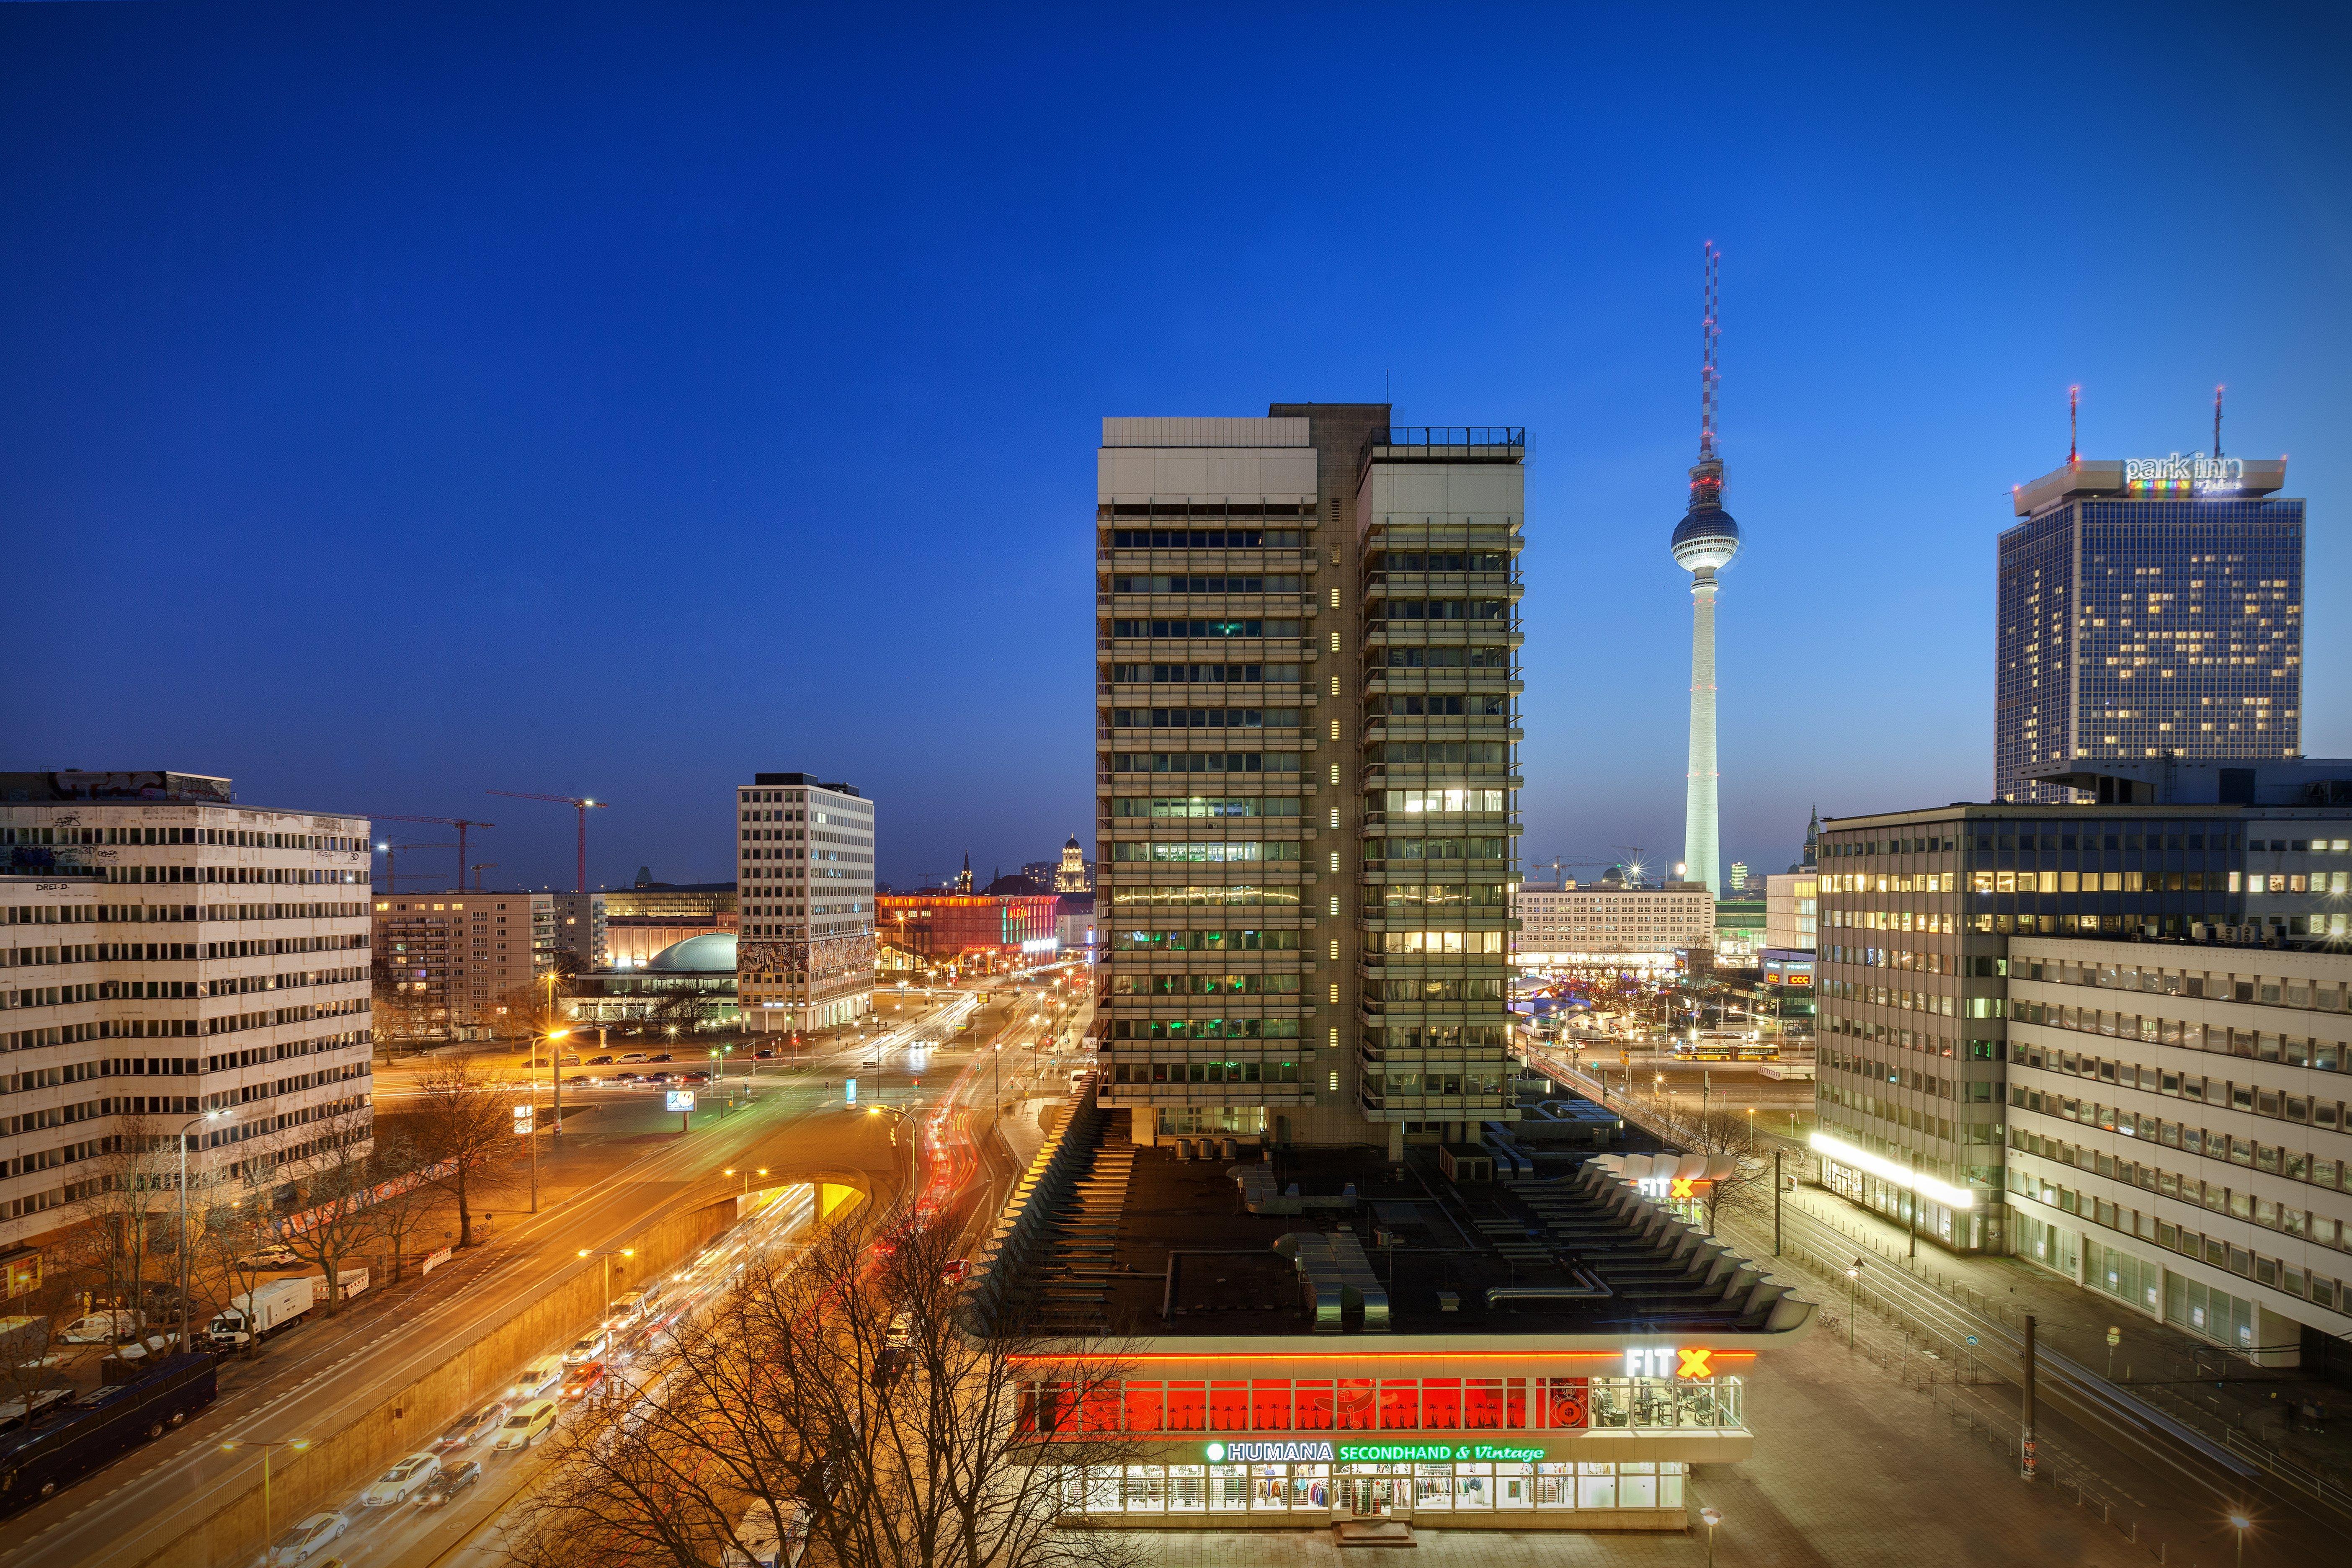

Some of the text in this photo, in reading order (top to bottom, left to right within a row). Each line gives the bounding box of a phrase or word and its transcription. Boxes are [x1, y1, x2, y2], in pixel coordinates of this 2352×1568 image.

[2126, 452, 2244, 483] park inn
[351, 852, 359, 861] 3D
[1009, 905, 1028, 923] ALEXA
[1228, 1442, 1545, 1463] HUMANA SECONDHAND & Vintage
